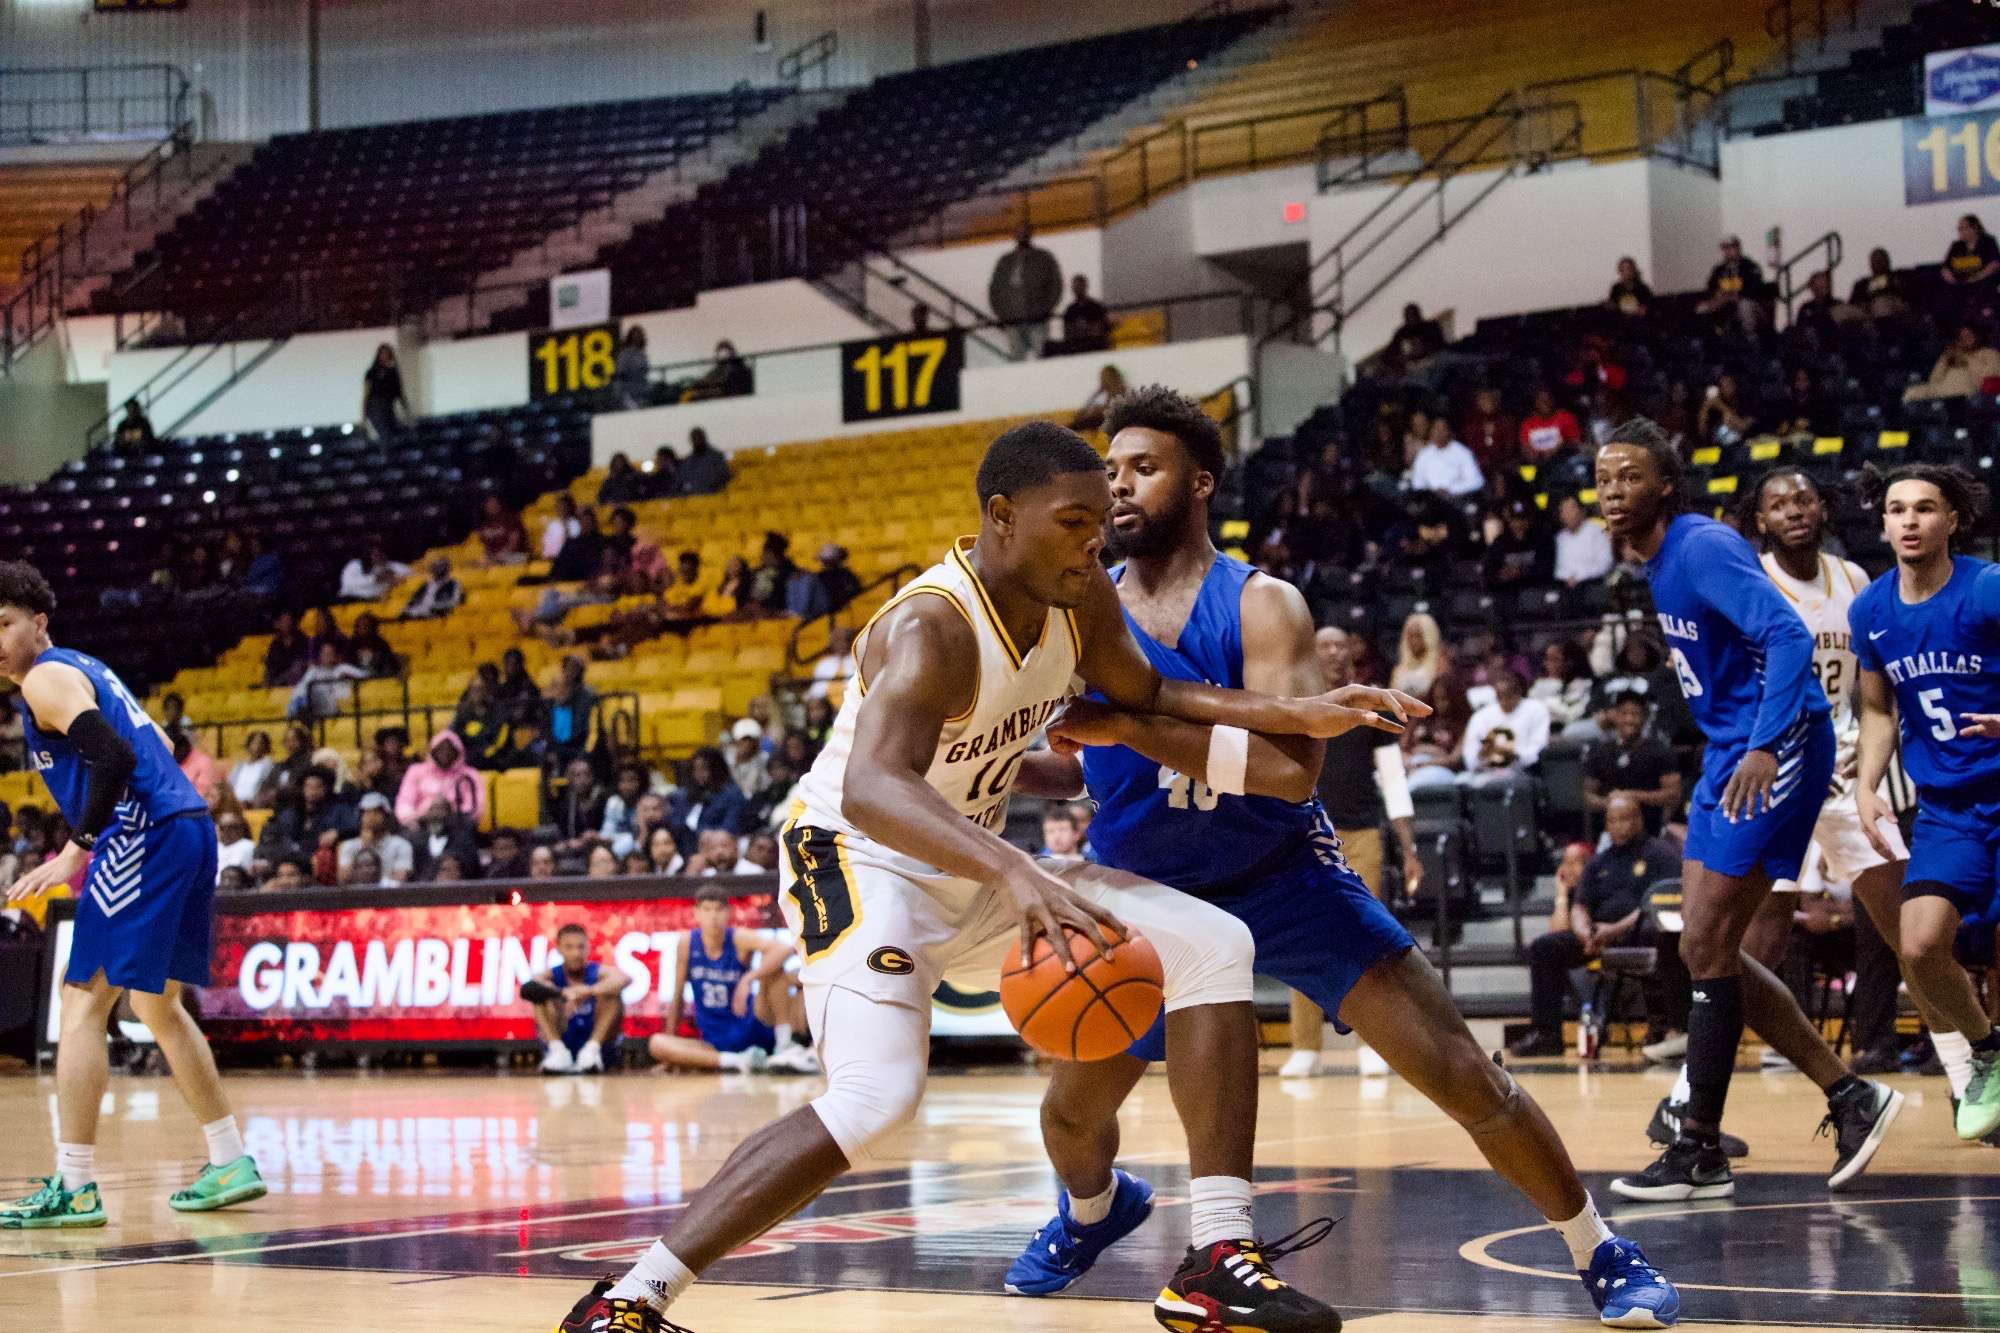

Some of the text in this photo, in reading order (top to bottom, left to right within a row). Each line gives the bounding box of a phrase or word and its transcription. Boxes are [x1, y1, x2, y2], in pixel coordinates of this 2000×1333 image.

[535, 330, 615, 394] 118
[853, 338, 946, 412] 117
[1903, 651, 1982, 679] DALLAS
[1918, 687, 1956, 742] 5
